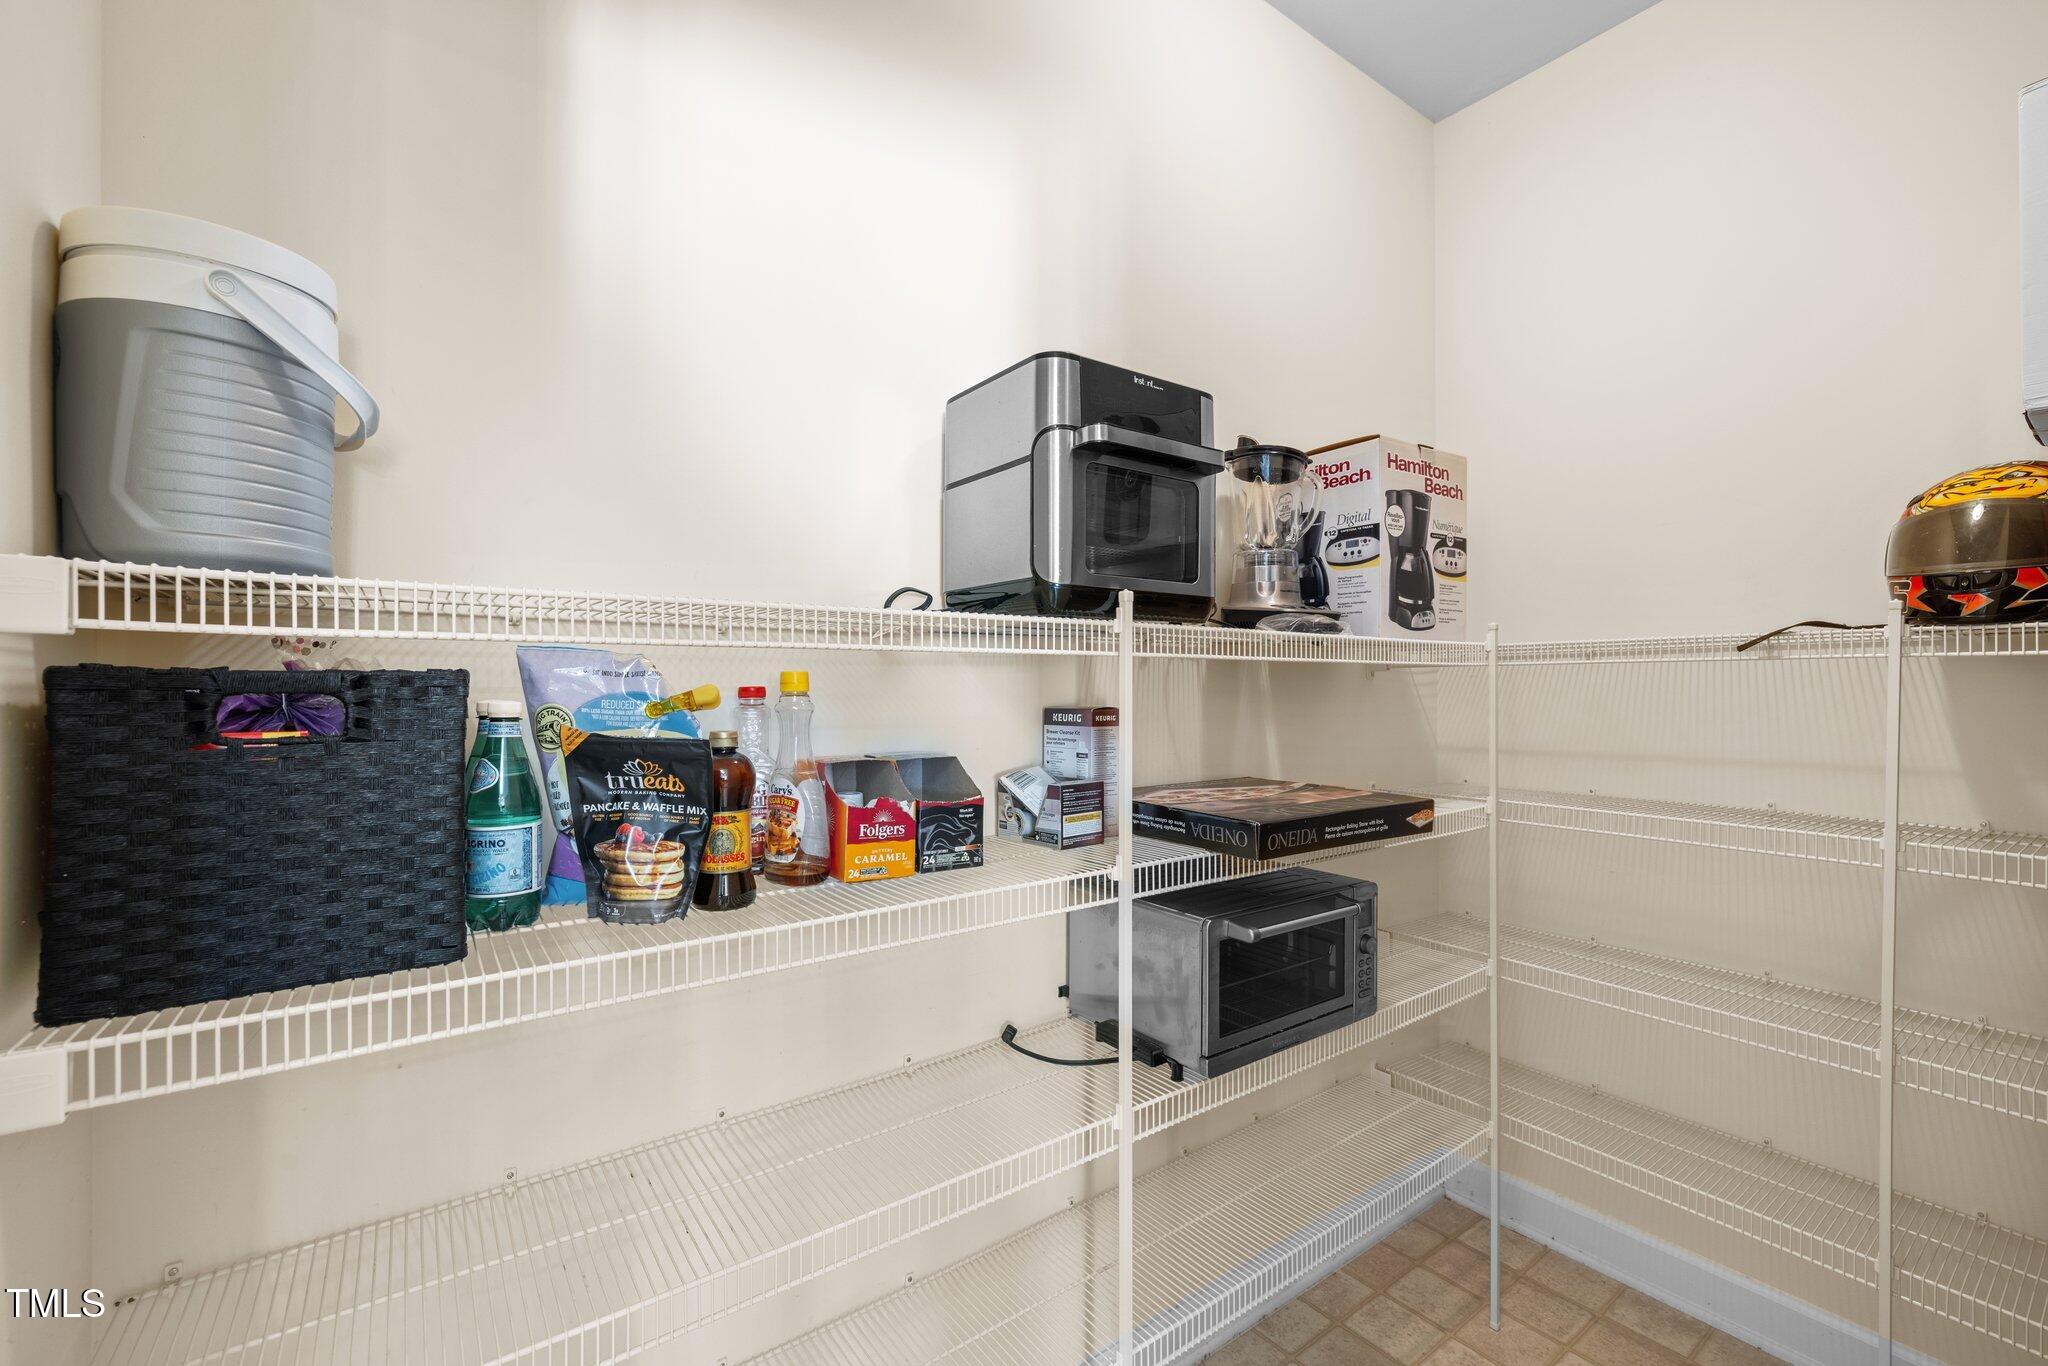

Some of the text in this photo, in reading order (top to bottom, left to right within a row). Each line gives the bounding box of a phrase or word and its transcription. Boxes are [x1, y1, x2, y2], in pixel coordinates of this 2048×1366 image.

[1310, 460, 1350, 476] ilton
[1387, 452, 1449, 481] Hamilton
[1321, 468, 1371, 489] Beach
[1424, 477, 1464, 500] Beach
[1336, 508, 1371, 527] Digital
[601, 700, 634, 709] REDUCED
[537, 710, 568, 724] BIG TRAIN
[1052, 713, 1082, 722] KEURIG
[604, 771, 686, 793] trueats
[771, 784, 792, 795] Cary's
[583, 802, 707, 815] PANCAKE & WAFFLE MIX
[781, 798, 796, 807] FREE
[859, 824, 906, 840] Folgers
[1190, 822, 1248, 848] ONEIDA
[1268, 828, 1318, 850] ONEIDA
[855, 852, 908, 864] CARAMEL
[923, 856, 935, 864] 24
[848, 869, 860, 878] 24
